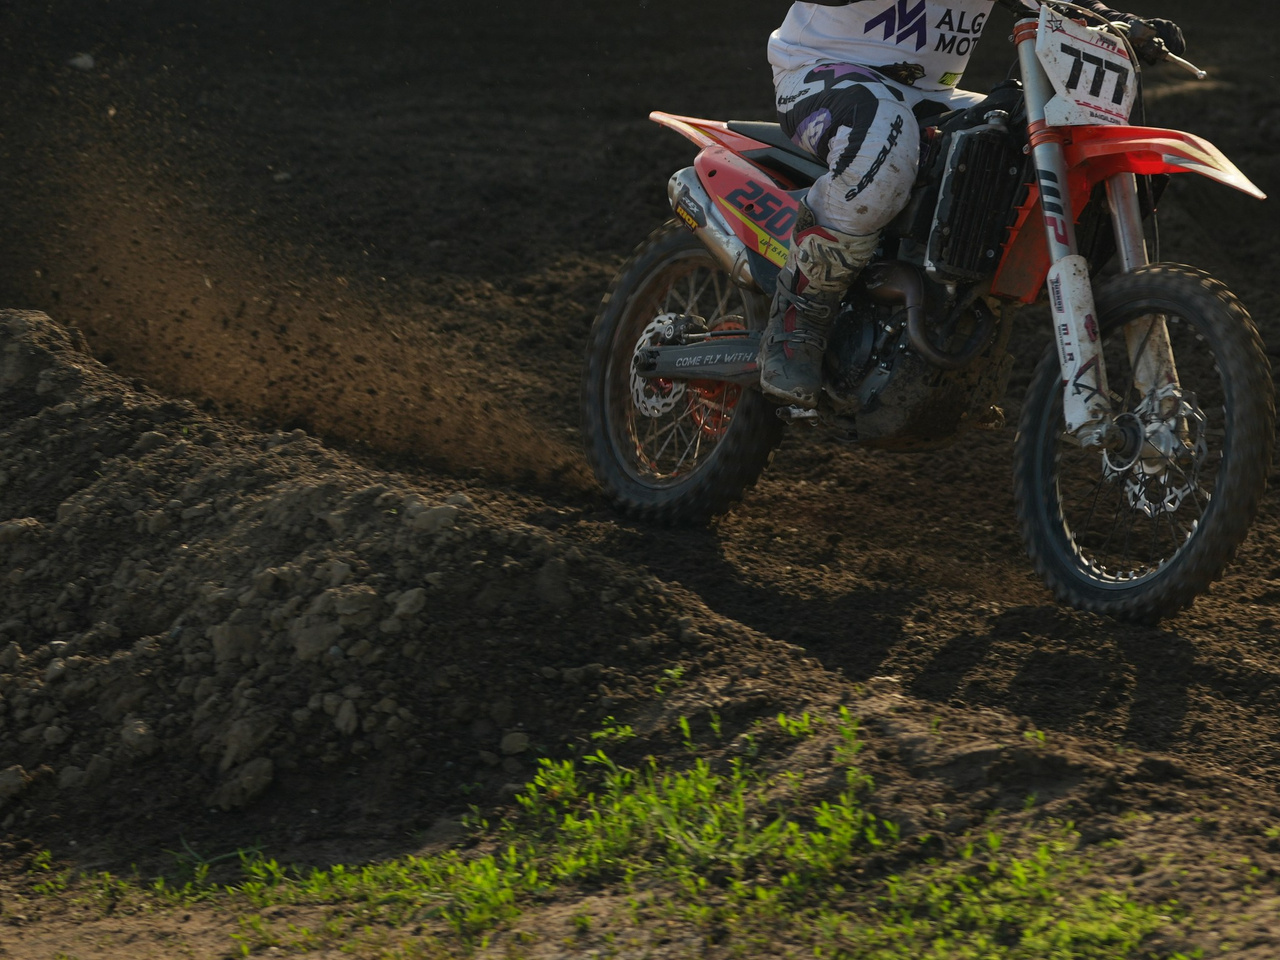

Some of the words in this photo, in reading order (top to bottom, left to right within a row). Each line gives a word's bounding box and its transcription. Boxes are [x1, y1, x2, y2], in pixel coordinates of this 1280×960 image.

[935, 8, 986, 35] ALG
[1060, 43, 1129, 106] 777
[676, 206, 699, 230] RIOT
[725, 180, 799, 237] 250
[675, 355, 703, 368] COME
[703, 353, 722, 365] FLY
[724, 351, 754, 363] WITH
